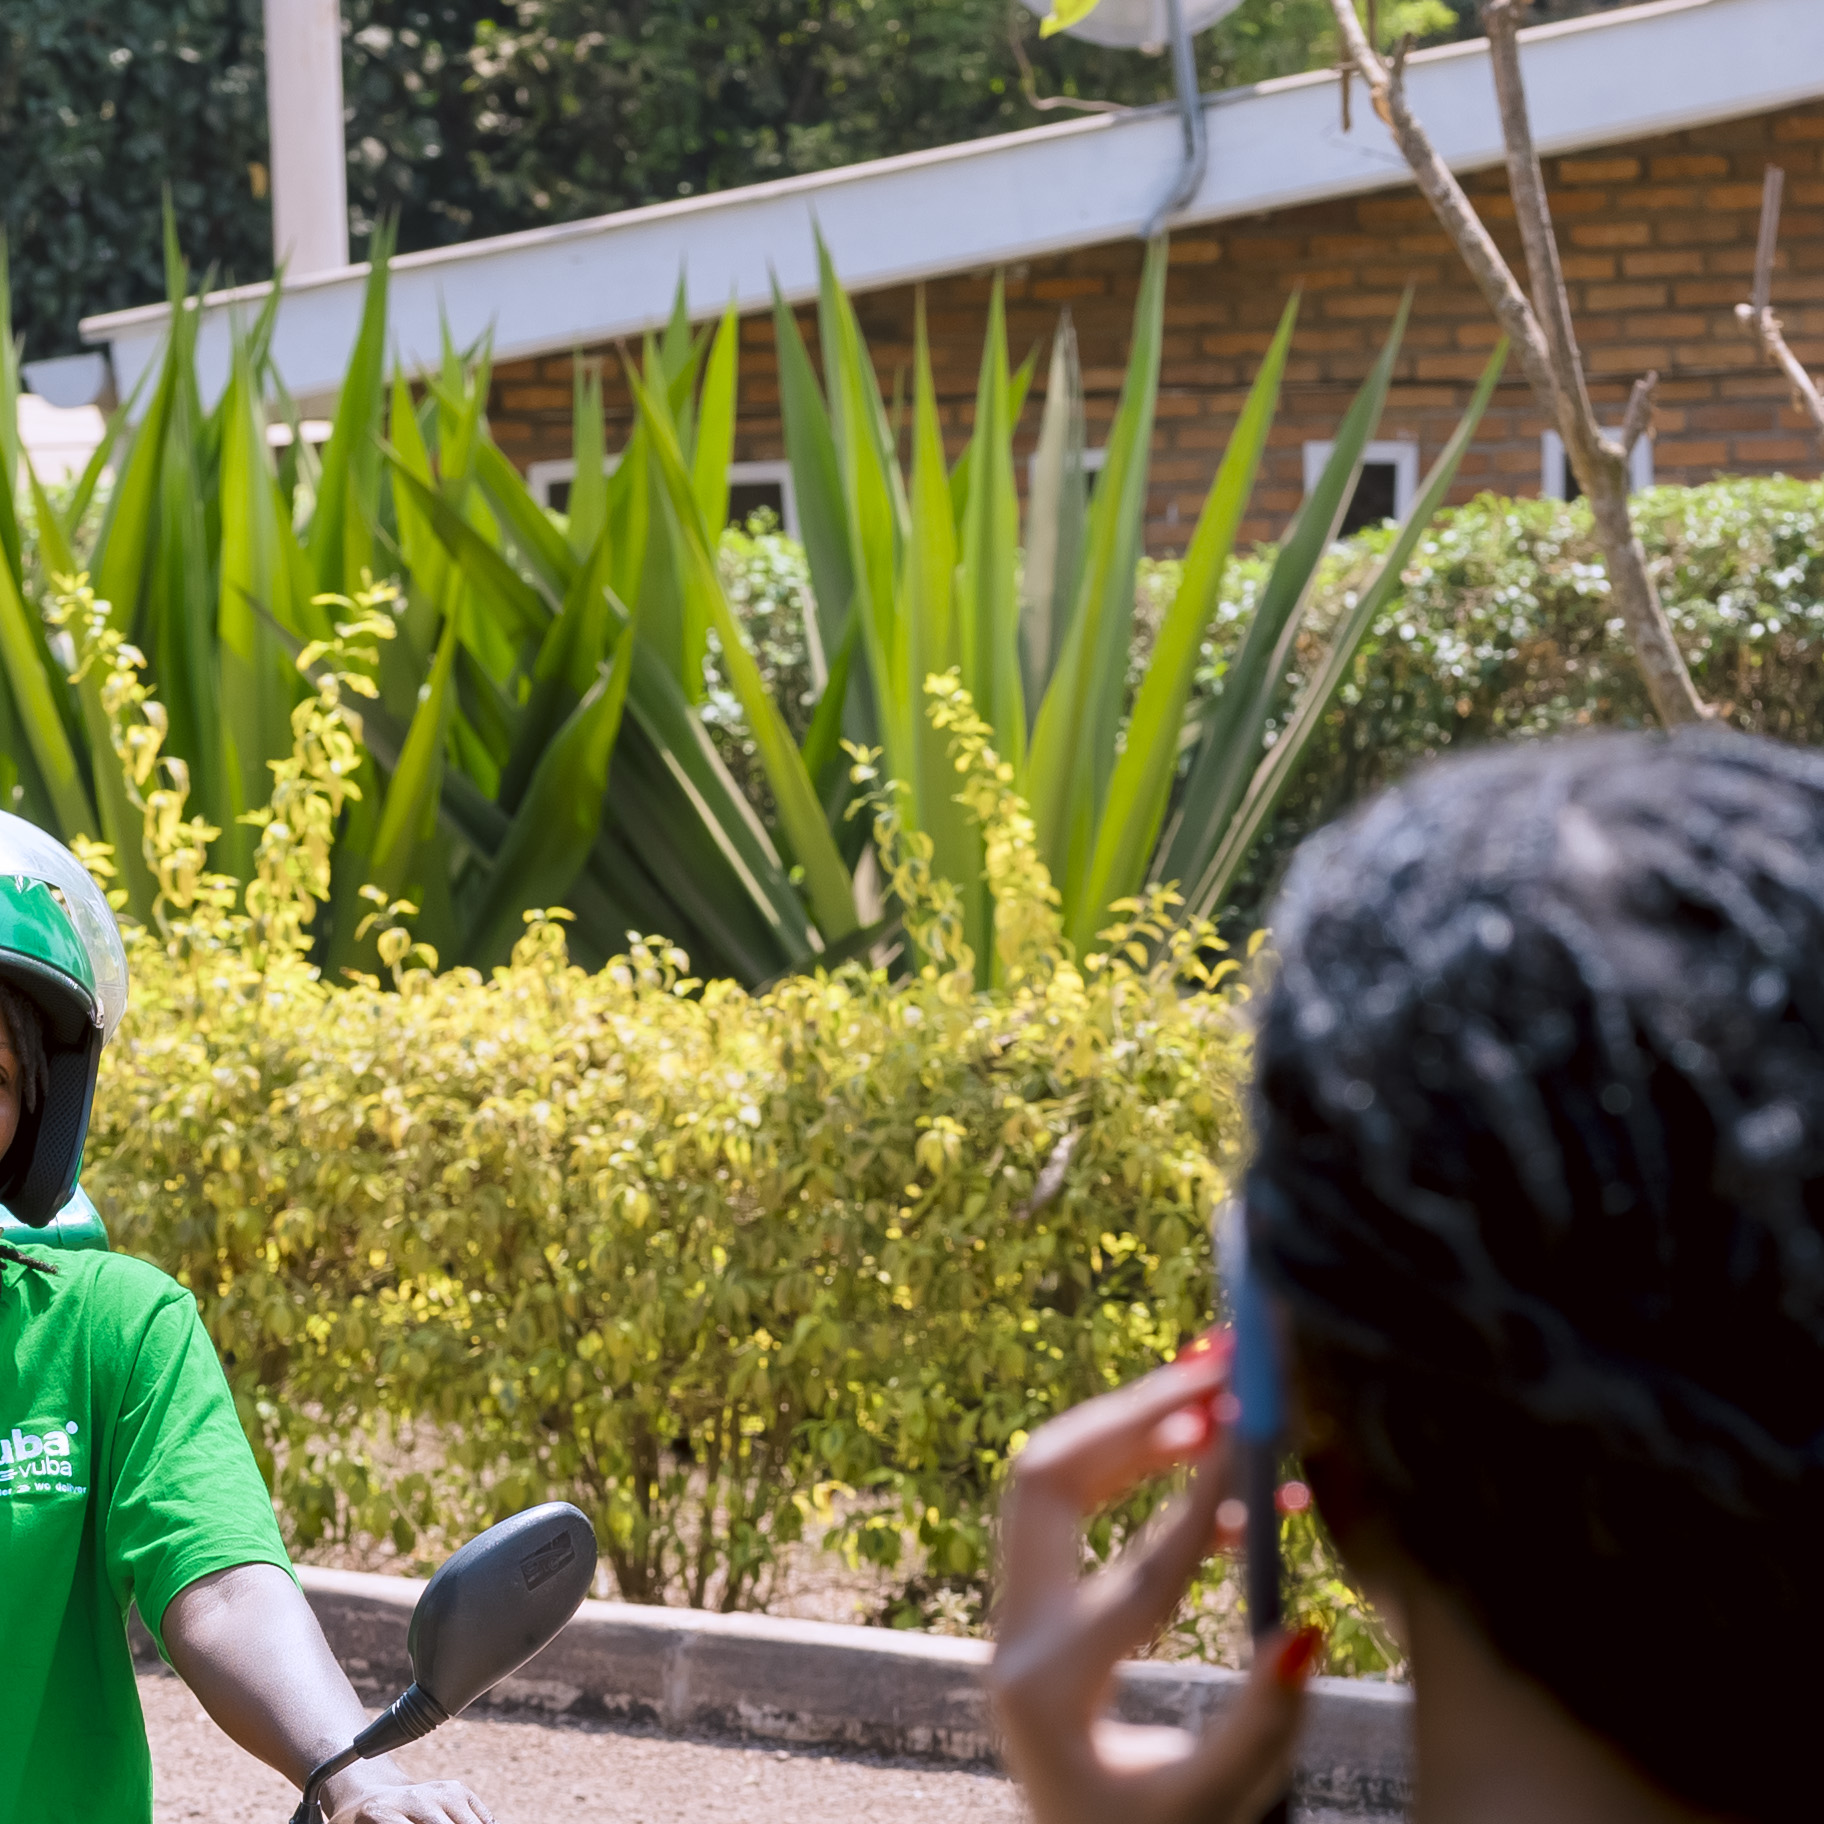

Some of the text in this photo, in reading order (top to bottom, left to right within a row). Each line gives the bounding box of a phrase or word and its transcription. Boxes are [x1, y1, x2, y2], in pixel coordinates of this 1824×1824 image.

[18, 1455, 73, 1478] vuba
[34, 1481, 51, 1492] we
[55, 1481, 87, 1494] deliver
